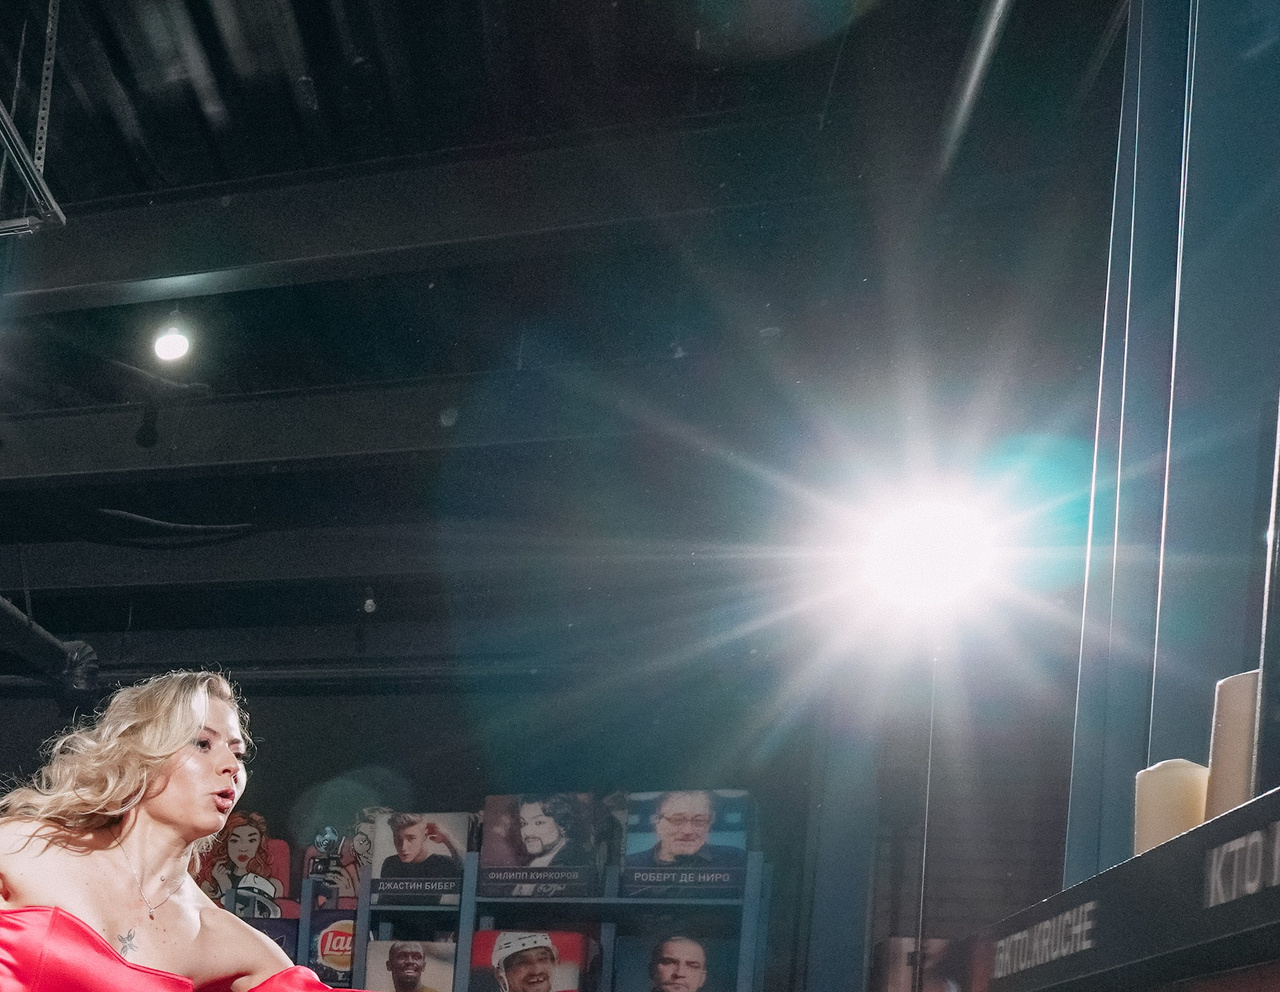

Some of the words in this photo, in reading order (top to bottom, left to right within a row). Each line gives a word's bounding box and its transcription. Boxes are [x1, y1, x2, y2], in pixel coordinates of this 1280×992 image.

[488, 871, 528, 880] ФИЛИПП
[530, 871, 579, 880] КИРКОРОВ
[634, 872, 676, 883] РОБЕРТ
[678, 873, 695, 884] ДЕ
[698, 873, 730, 883] НИРО
[378, 881, 423, 891] ДЖАСТИН
[424, 881, 456, 891] БИБЕР
